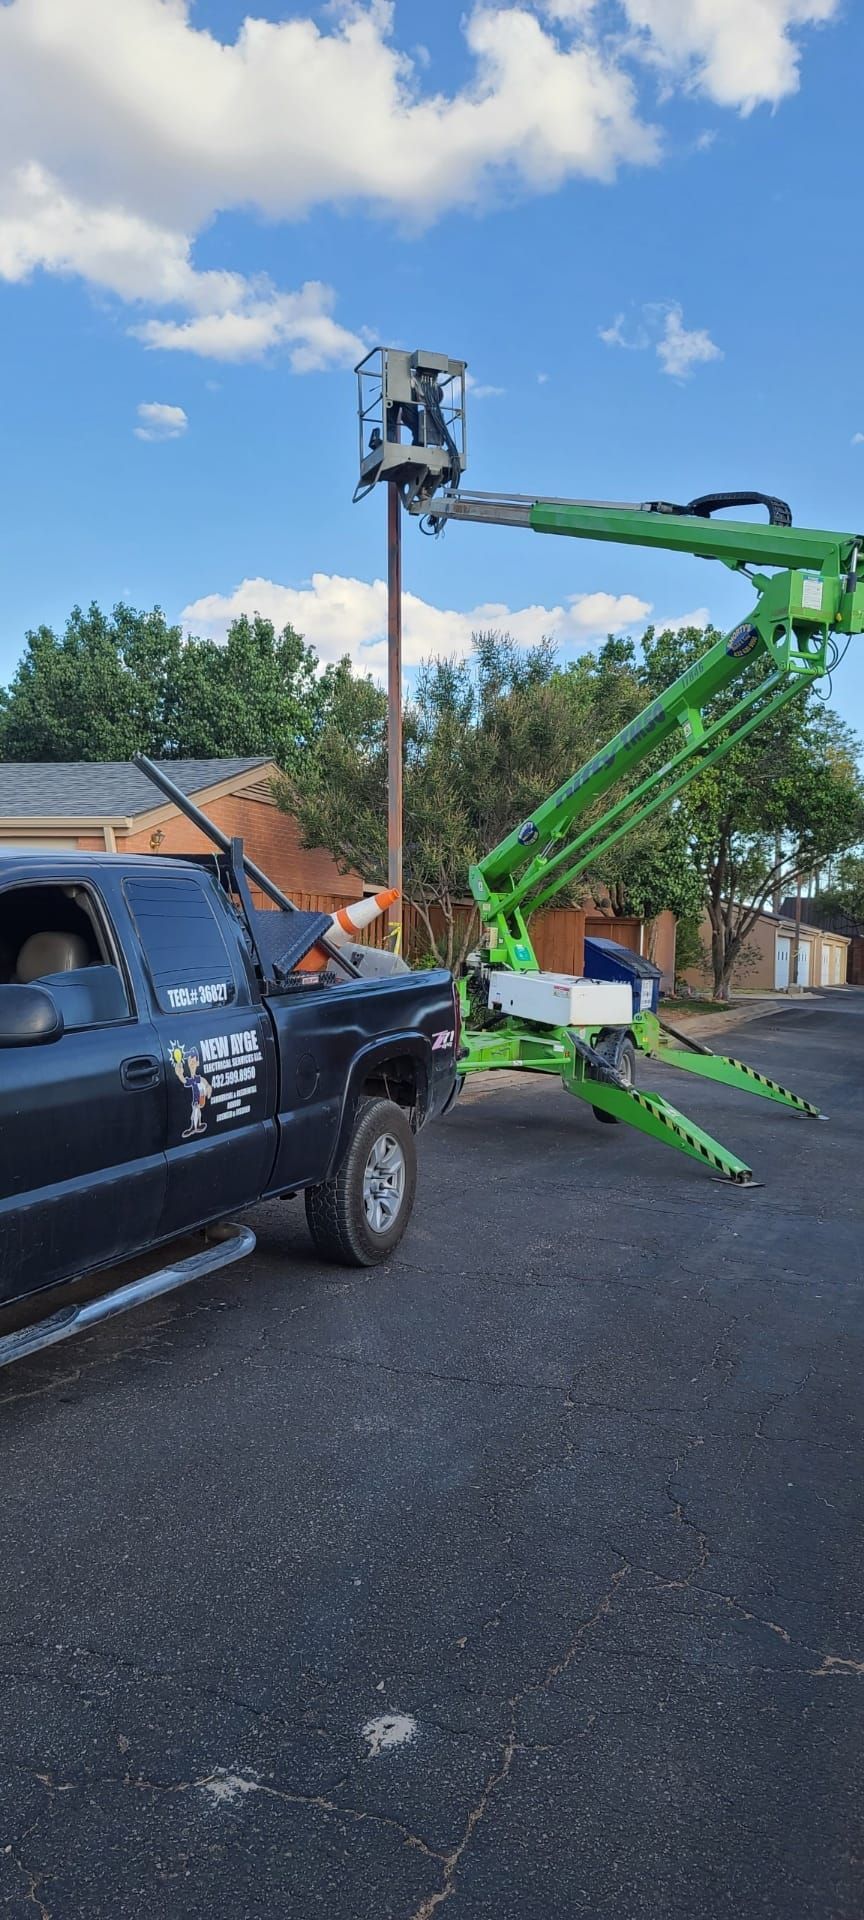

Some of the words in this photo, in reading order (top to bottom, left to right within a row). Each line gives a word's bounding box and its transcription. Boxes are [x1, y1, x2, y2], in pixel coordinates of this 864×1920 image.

[167, 987, 198, 1009] TECL#
[199, 983, 227, 1004] 36827
[200, 1035, 229, 1062] NEW
[230, 1030, 259, 1056] AYGE
[432, 1030, 455, 1050] Z71
[203, 1059, 232, 1074] ELECTRICAL
